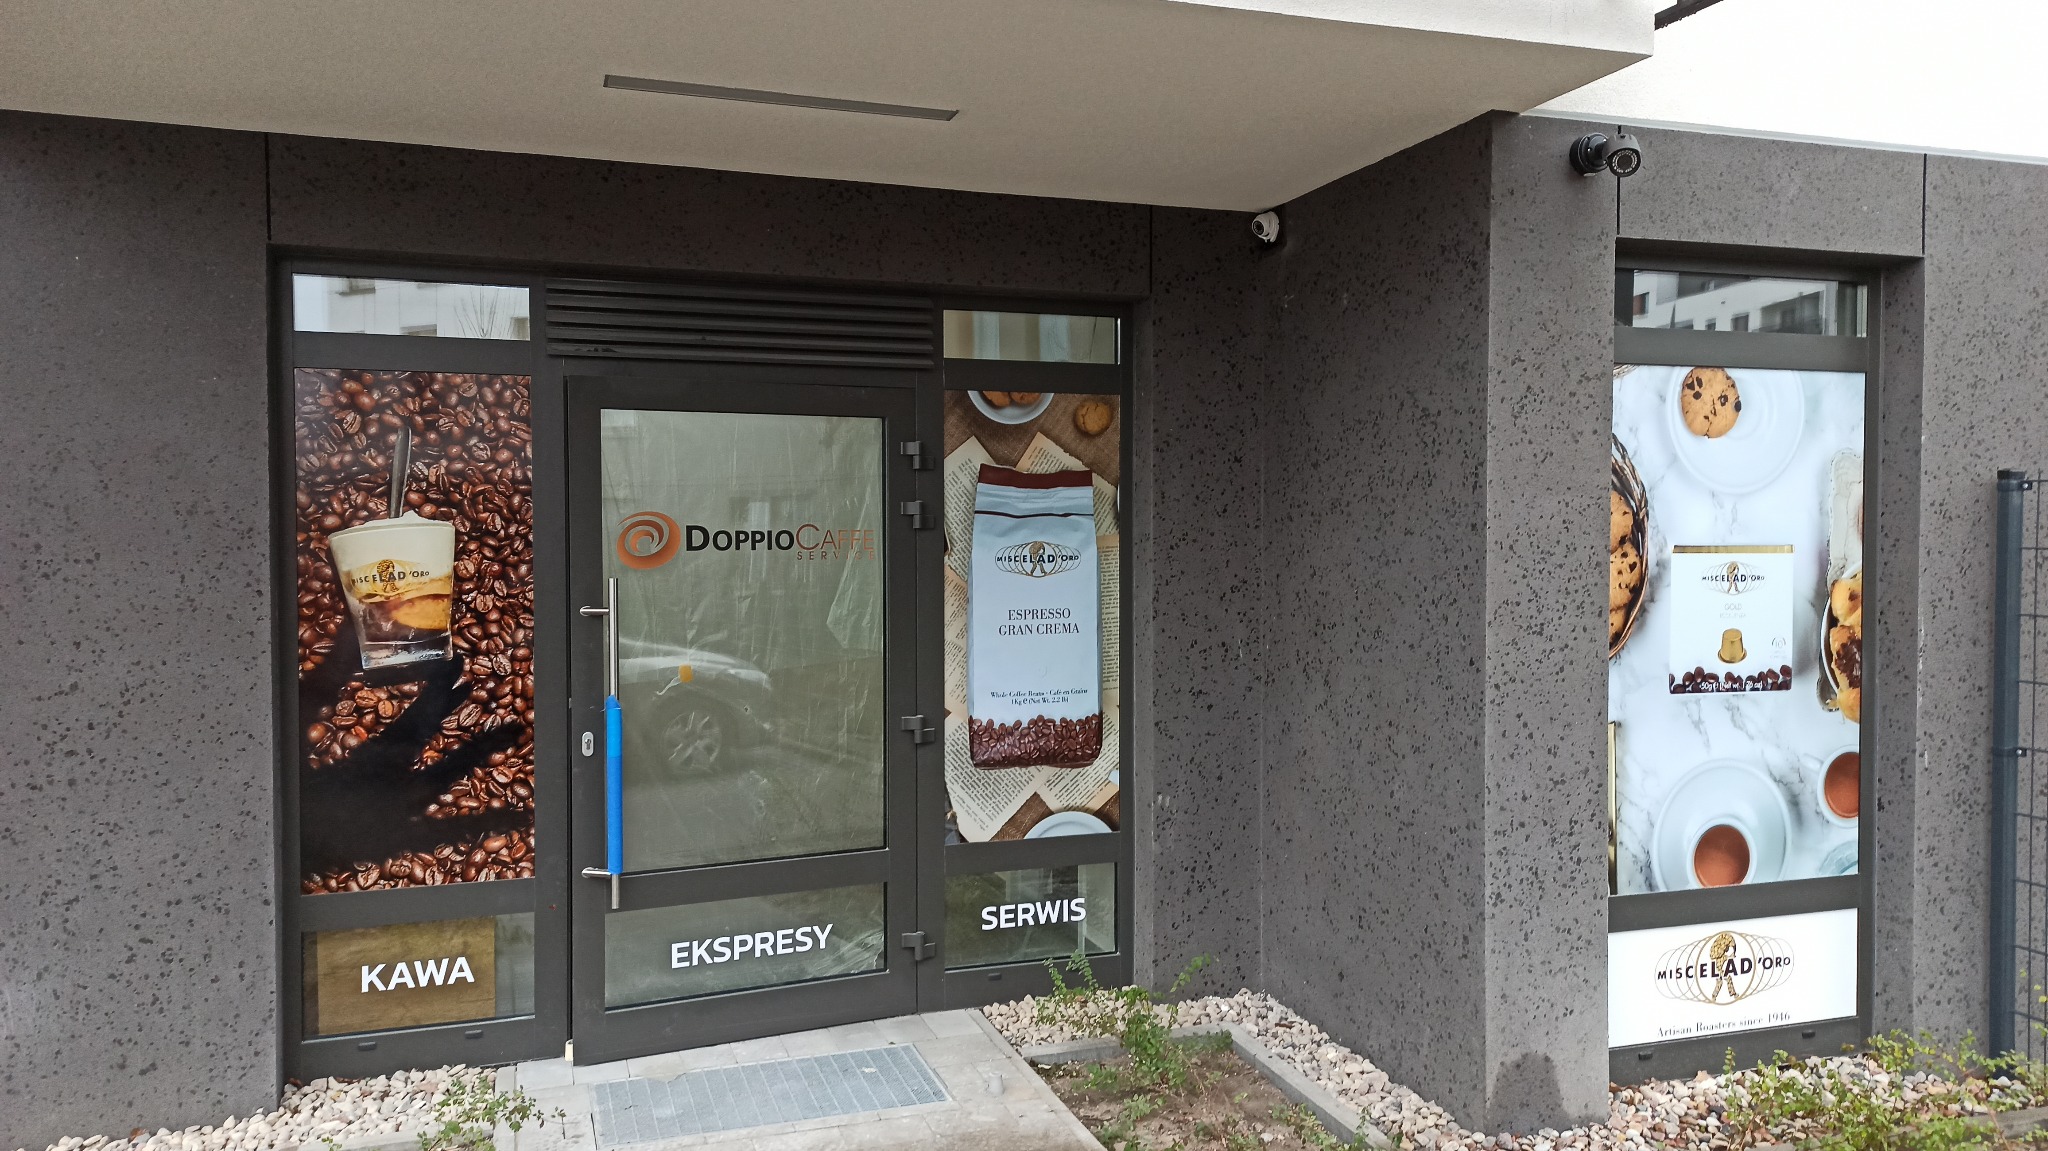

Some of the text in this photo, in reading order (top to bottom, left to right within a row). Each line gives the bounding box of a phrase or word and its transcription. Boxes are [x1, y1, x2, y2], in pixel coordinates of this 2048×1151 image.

[796, 551, 875, 561] SERVICE
[1008, 607, 1071, 621] ESPRESSO
[998, 622, 1080, 636] GRAN CREMA
[981, 897, 1087, 932] SERWIS
[670, 923, 834, 970] EKSPRESY
[361, 956, 476, 994] KAWA
[1657, 1025, 1692, 1038] Artisan
[1695, 1021, 1736, 1033] Roasters
[1739, 1015, 1763, 1026] since
